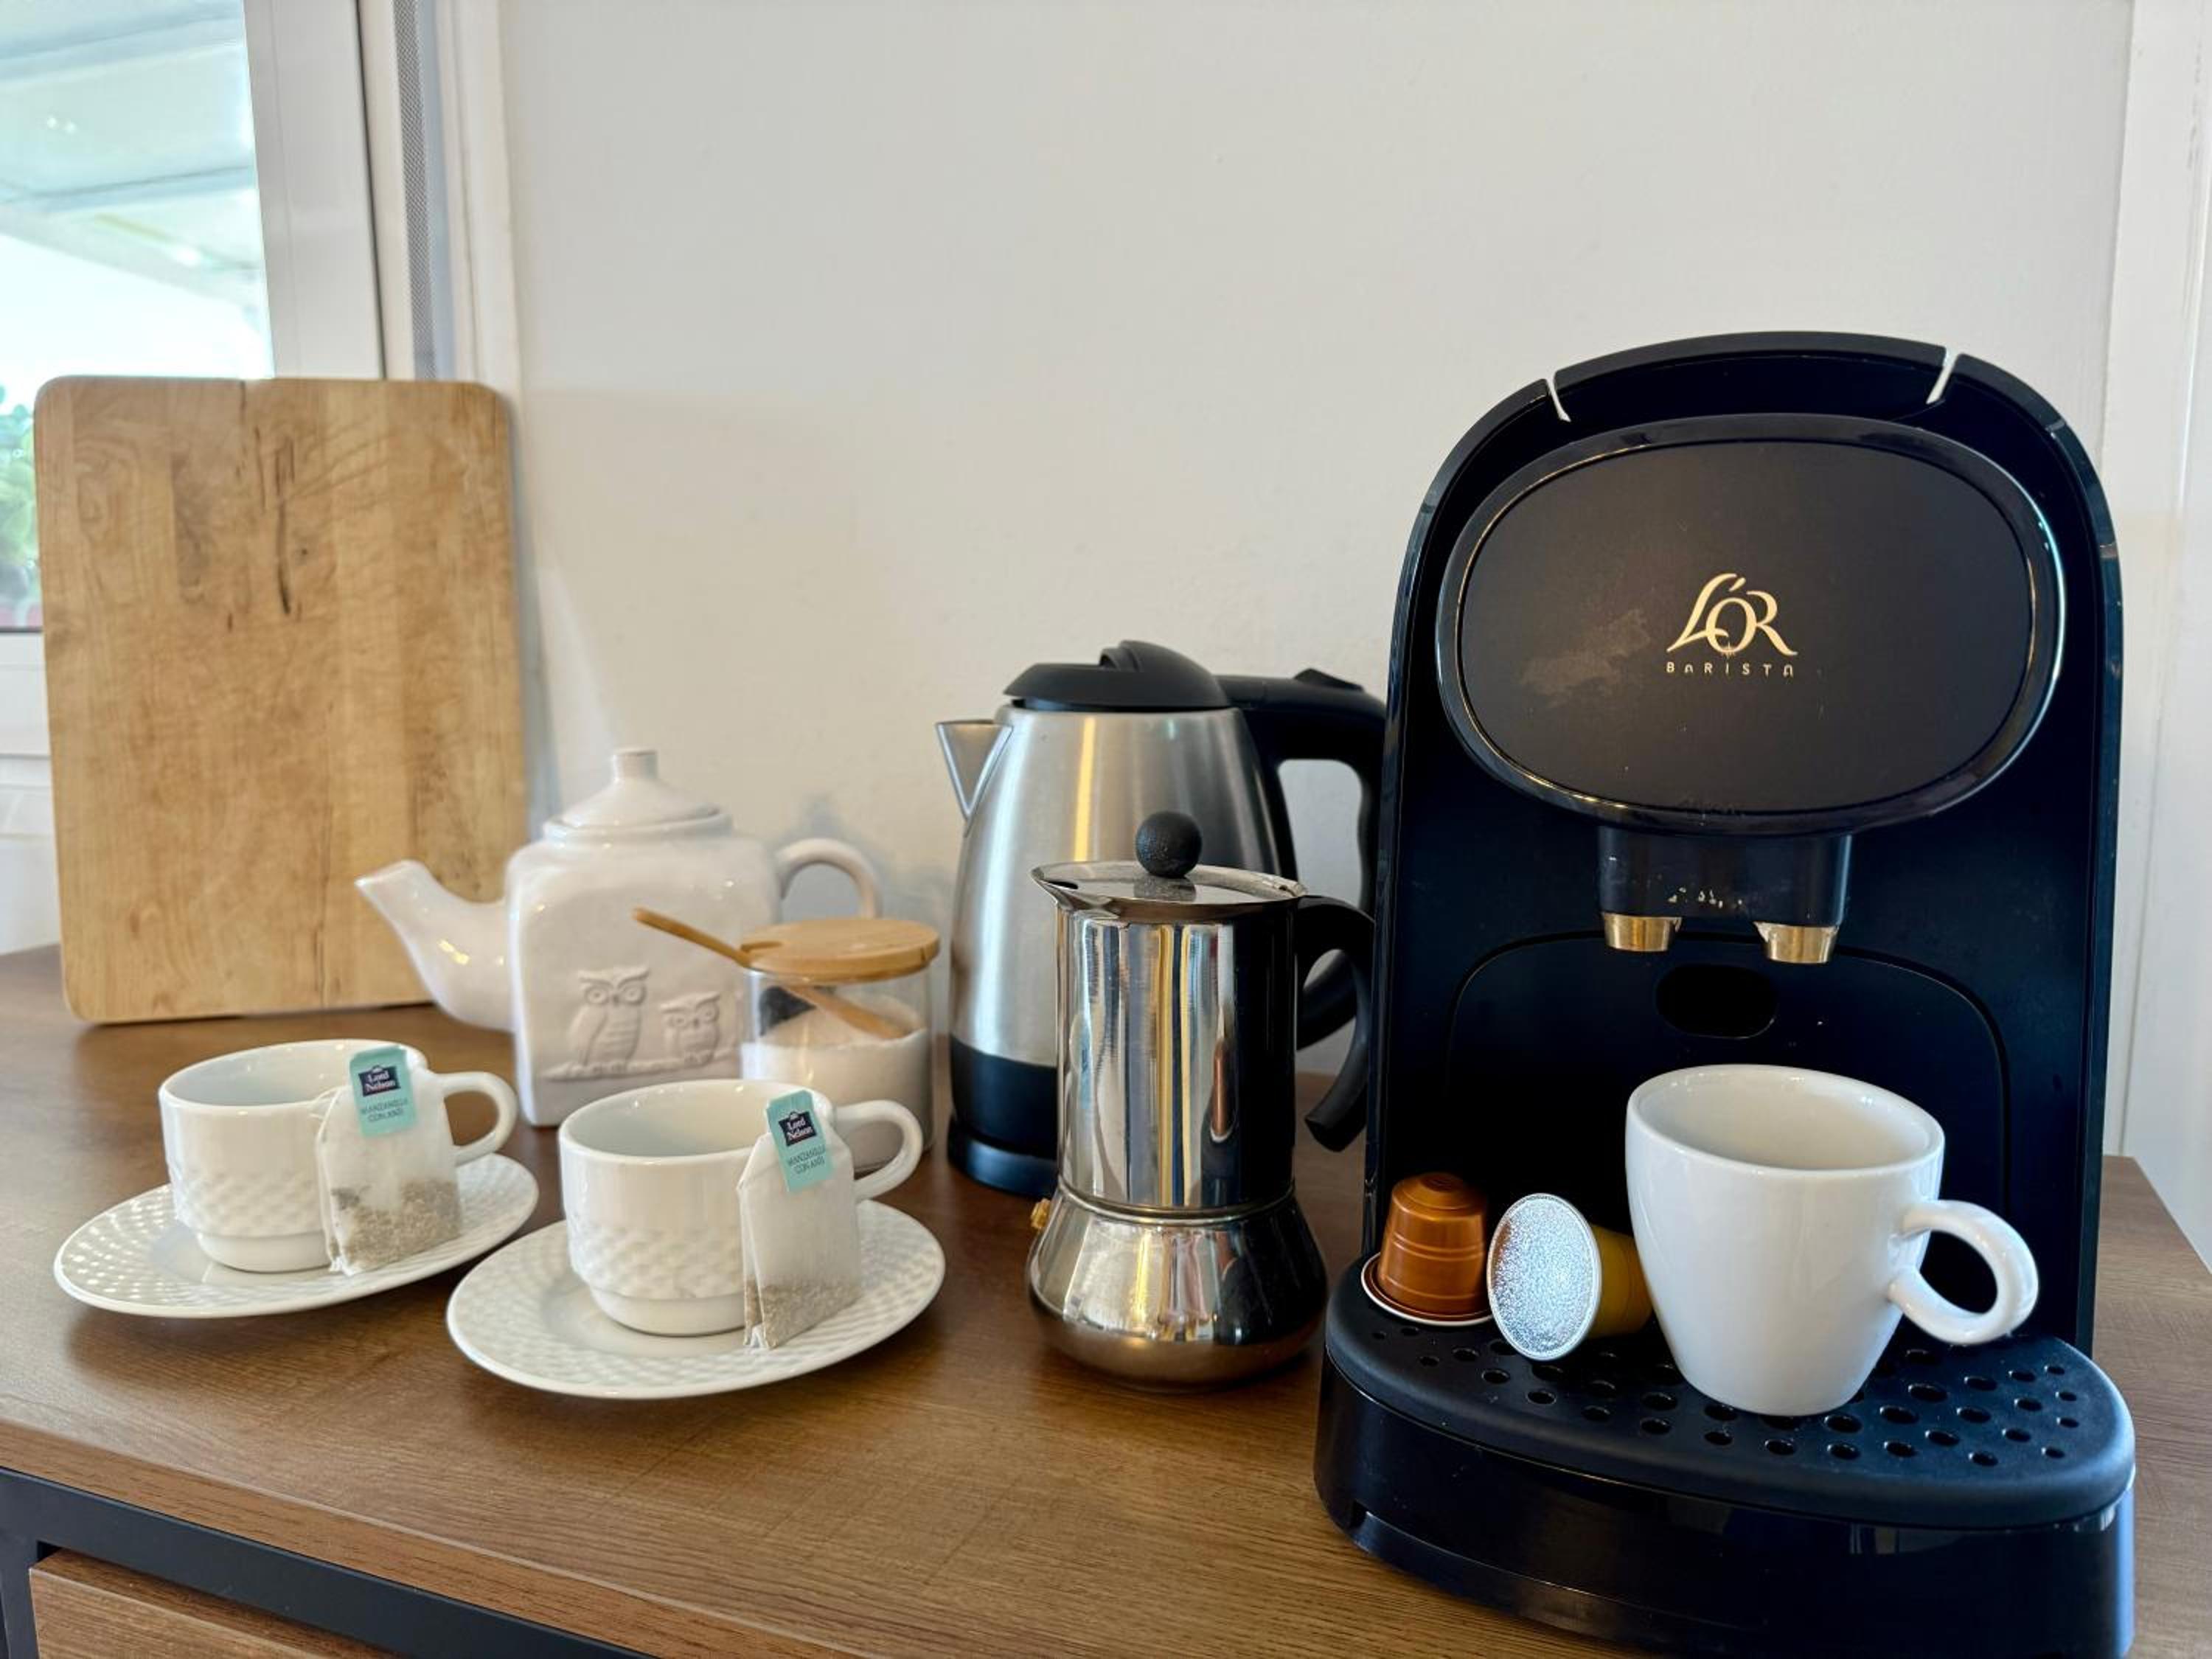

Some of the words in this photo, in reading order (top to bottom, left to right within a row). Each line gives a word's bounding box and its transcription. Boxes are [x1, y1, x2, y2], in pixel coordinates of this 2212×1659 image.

[1666, 661, 1794, 677] BARISTA
[368, 1070, 390, 1083] Lord
[365, 1080, 396, 1092] Nelson
[786, 1116, 806, 1130] Lord
[787, 1127, 814, 1141] Nelson
